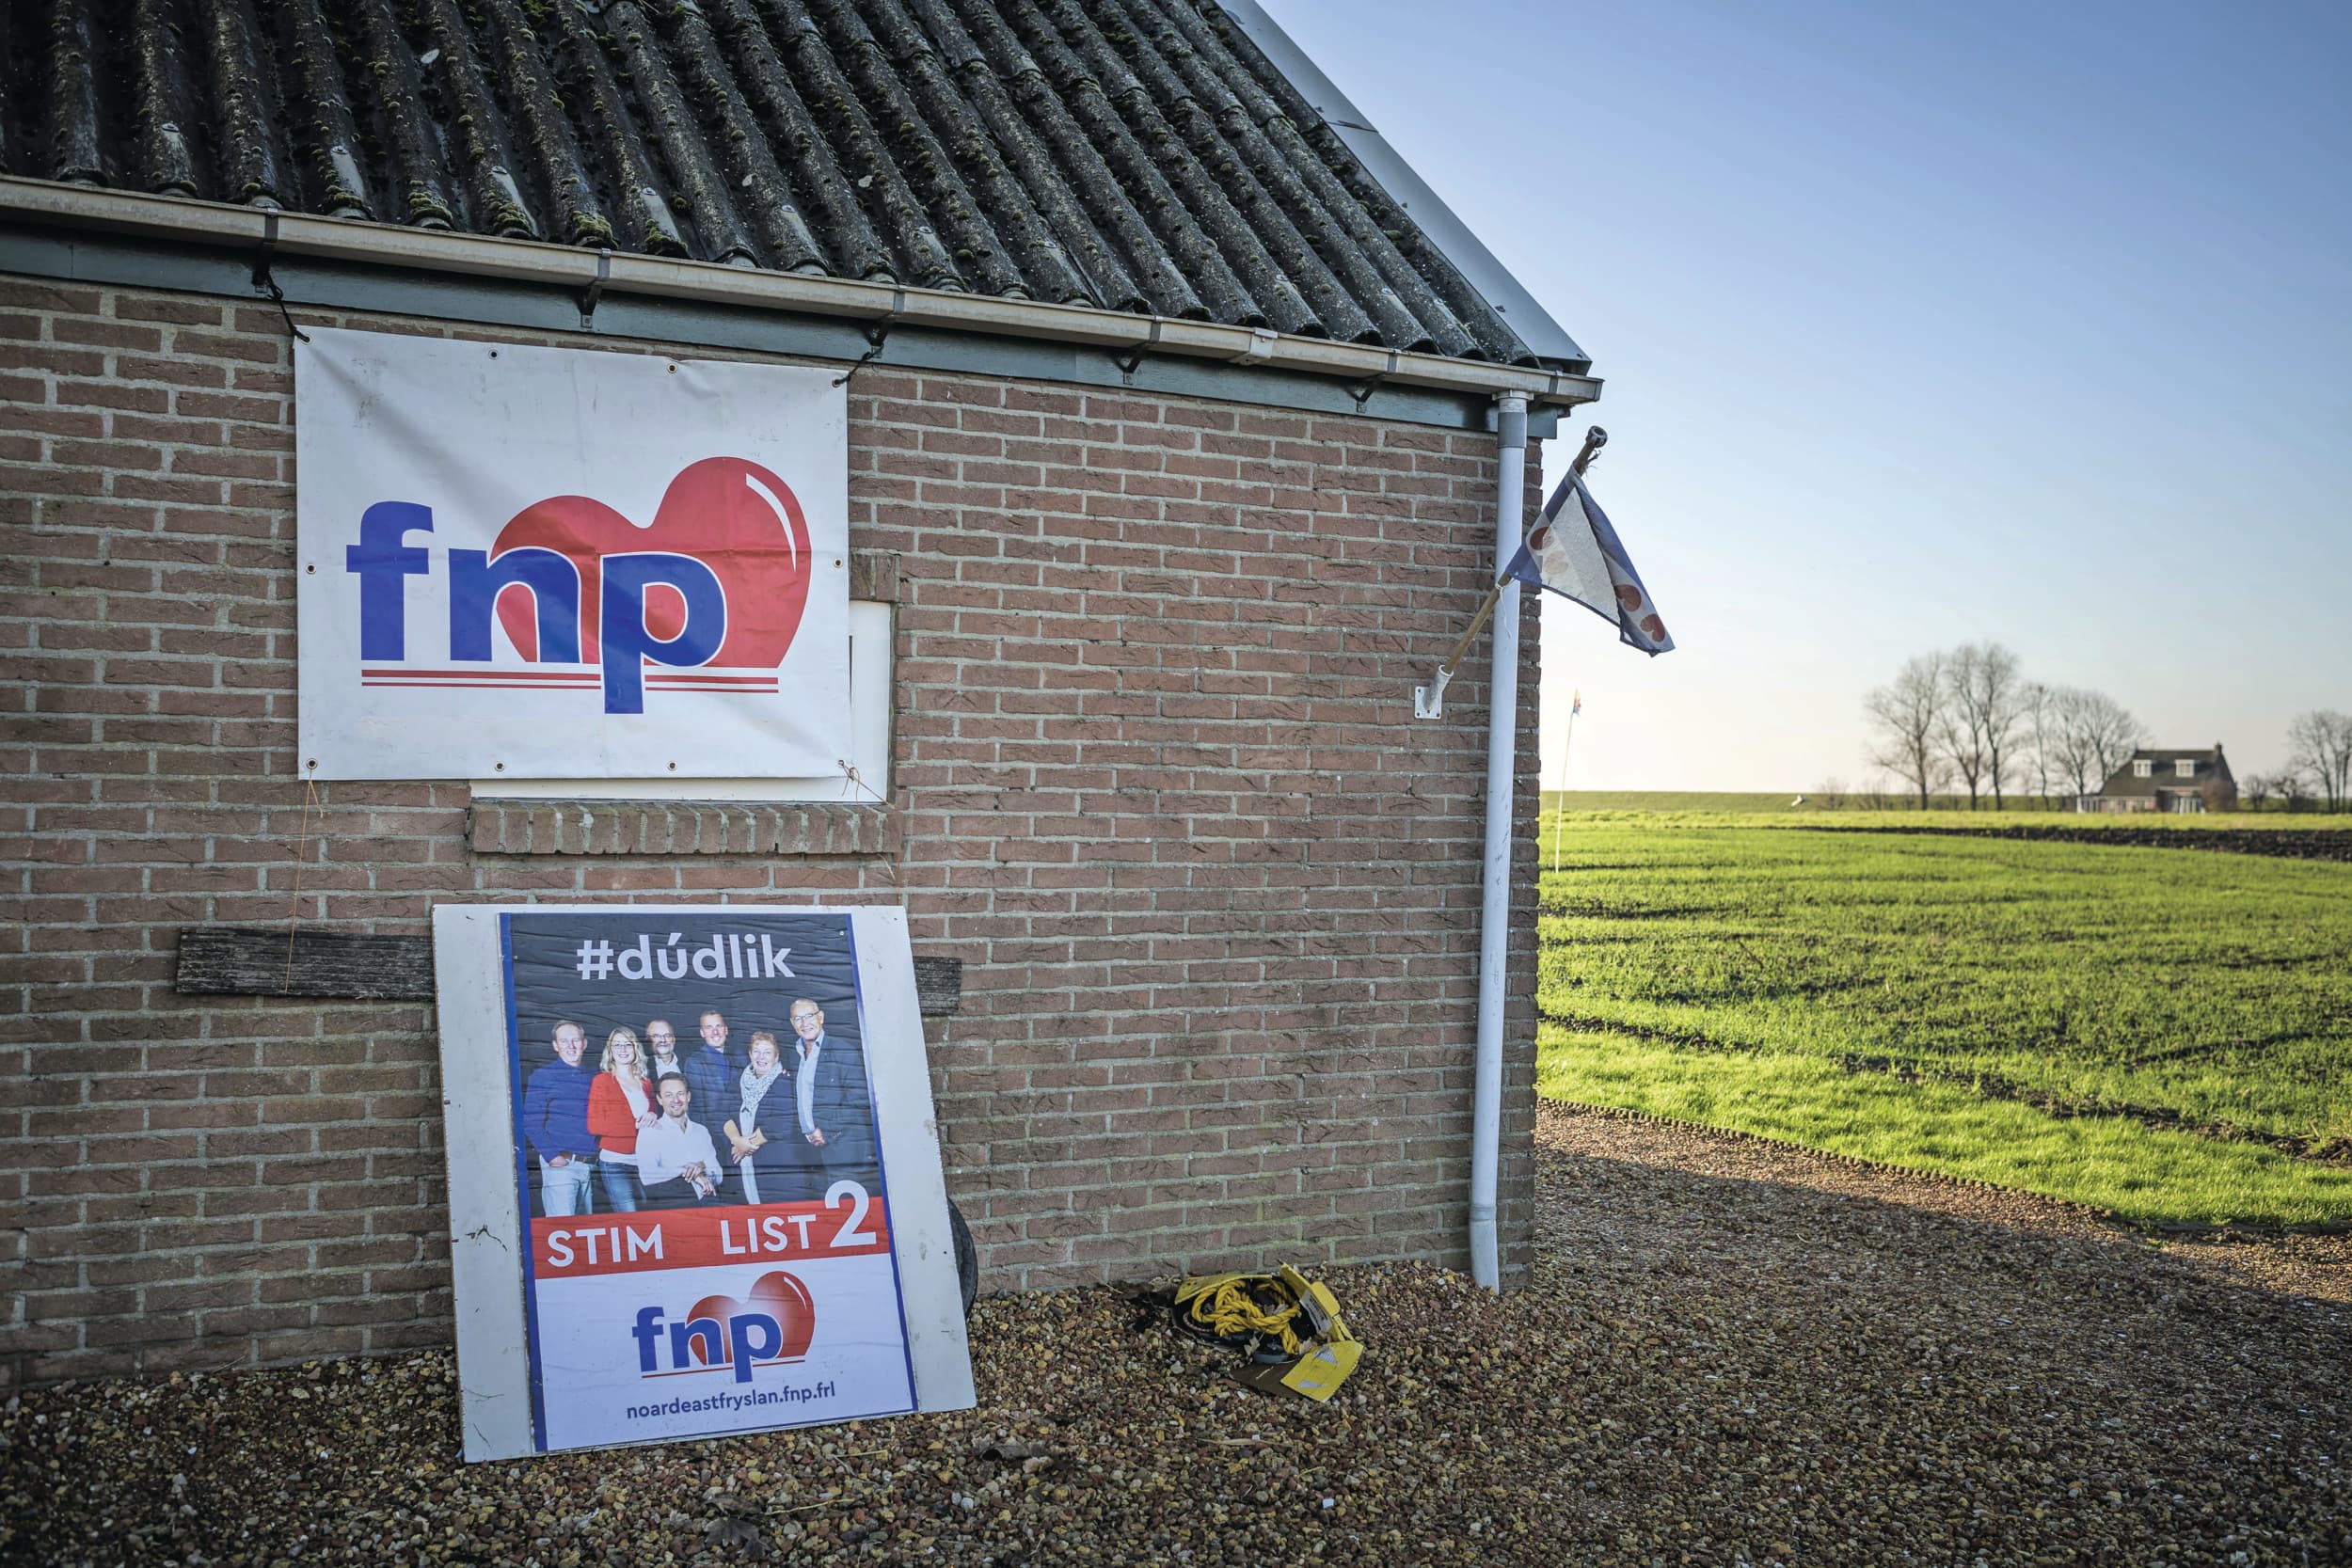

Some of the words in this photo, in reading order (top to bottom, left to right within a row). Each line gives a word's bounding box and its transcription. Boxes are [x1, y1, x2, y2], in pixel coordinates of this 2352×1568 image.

[346, 500, 727, 714] fnp
[576, 933, 796, 981] #dúdlik
[548, 1224, 664, 1267] STIM
[721, 1214, 817, 1255] LIST
[824, 1180, 876, 1248] 2
[632, 1307, 783, 1383] fnp
[627, 1382, 835, 1419] noardeastfryslan.fnp.frl
